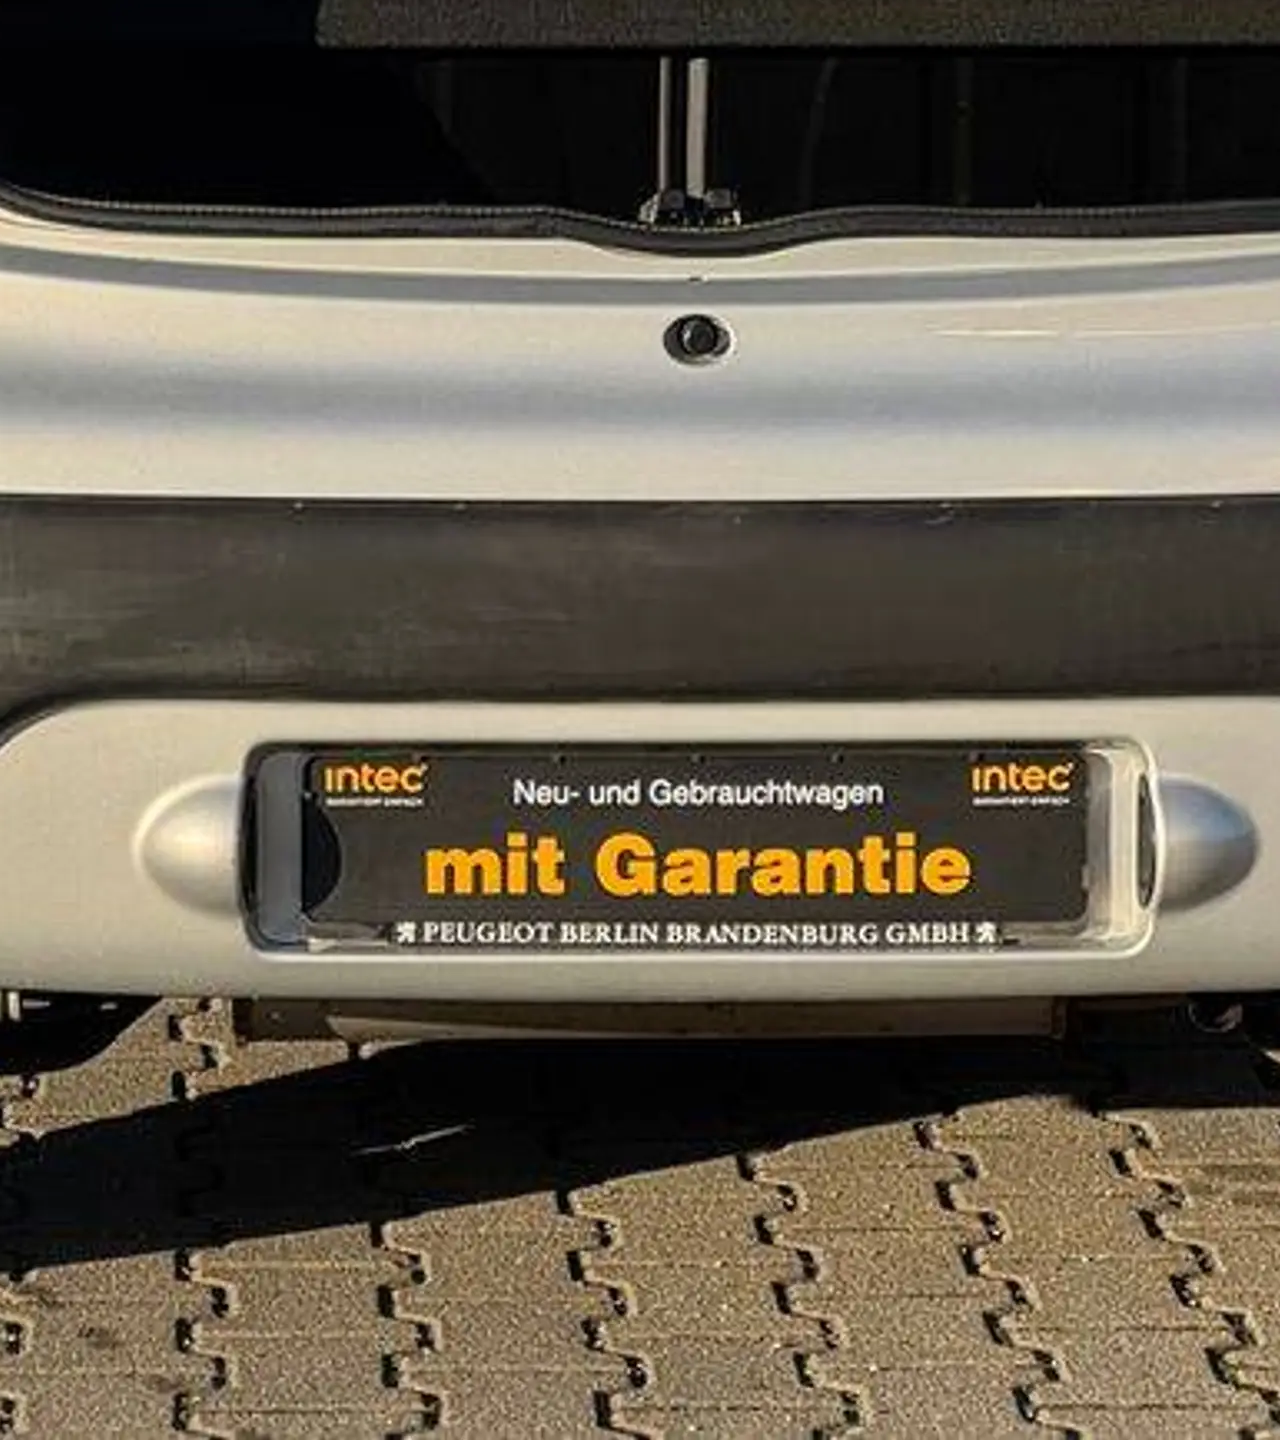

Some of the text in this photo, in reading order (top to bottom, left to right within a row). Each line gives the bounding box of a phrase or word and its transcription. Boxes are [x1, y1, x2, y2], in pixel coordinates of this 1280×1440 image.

[324, 763, 428, 793] intec
[972, 762, 1074, 792] intec
[513, 779, 884, 811] Neu- und Gebrauchtwagen
[425, 832, 972, 894] mit Garantie
[423, 921, 969, 945] PEUGEOT BERLIN BRANDENBURG GMBH
